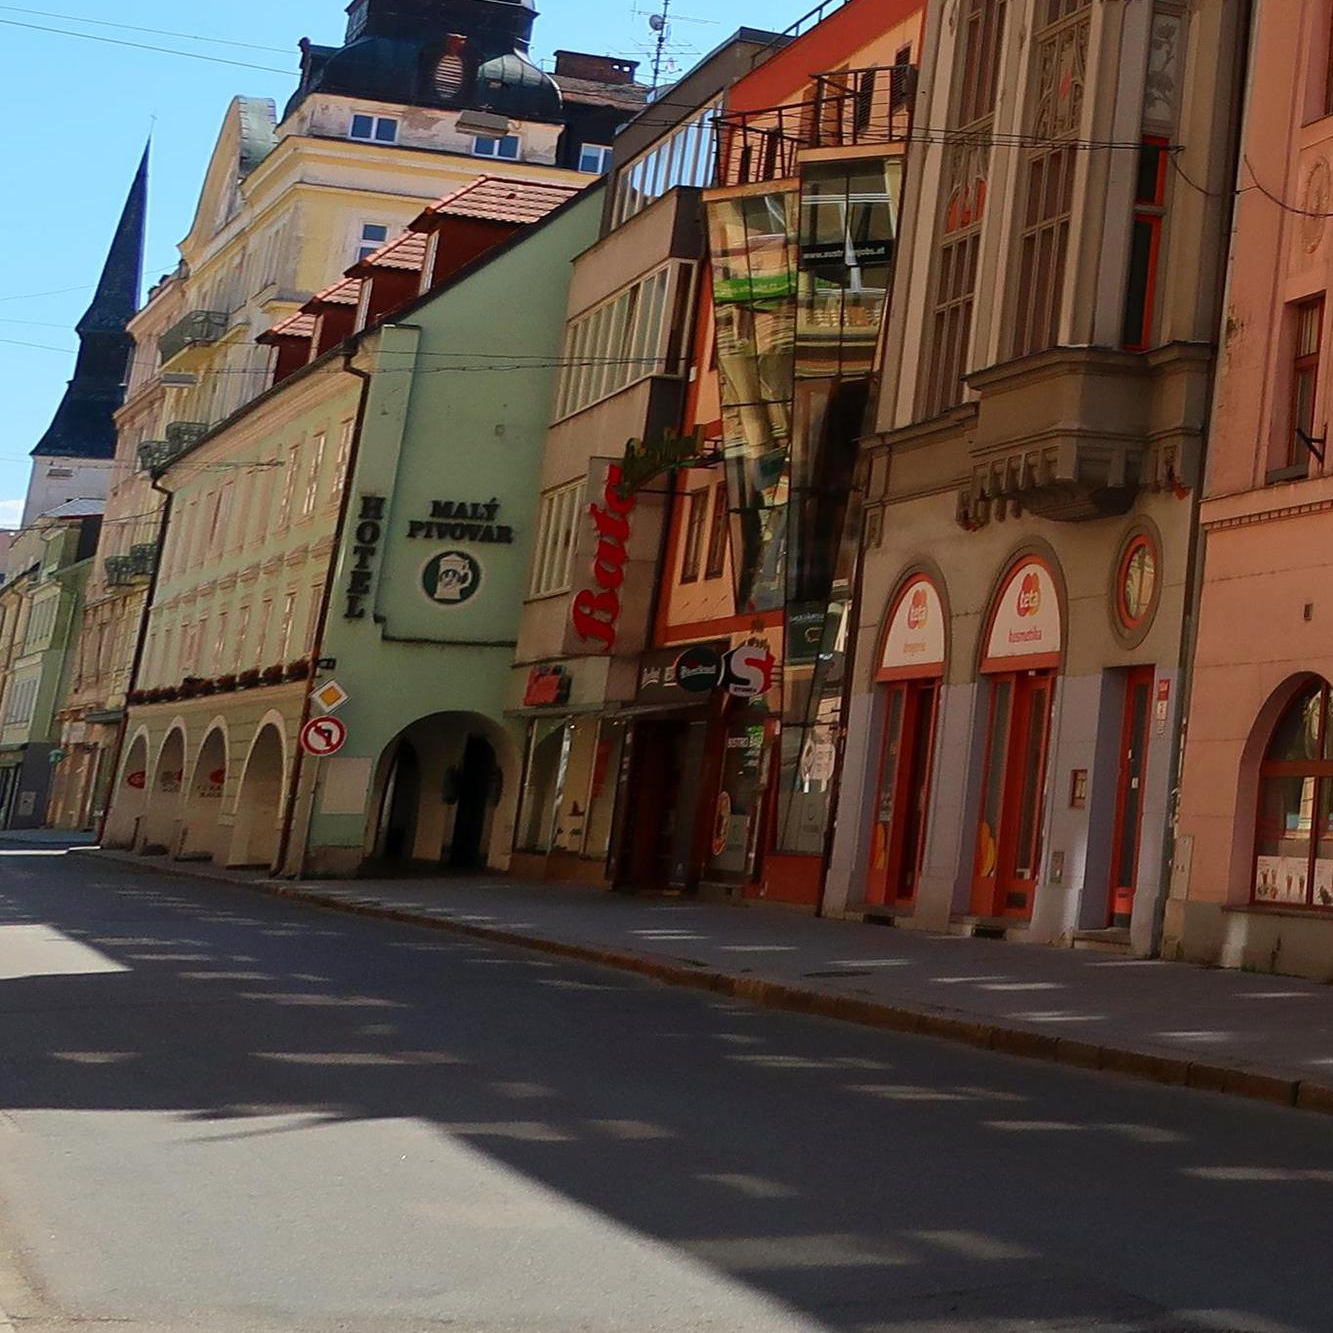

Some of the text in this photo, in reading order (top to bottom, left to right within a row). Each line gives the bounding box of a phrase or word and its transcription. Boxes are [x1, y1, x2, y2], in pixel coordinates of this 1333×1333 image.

[430, 497, 500, 521] MALÝ
[406, 520, 514, 545] PIVOVAR
[344, 495, 387, 620] HOTEL
[1019, 590, 1040, 608] teta
